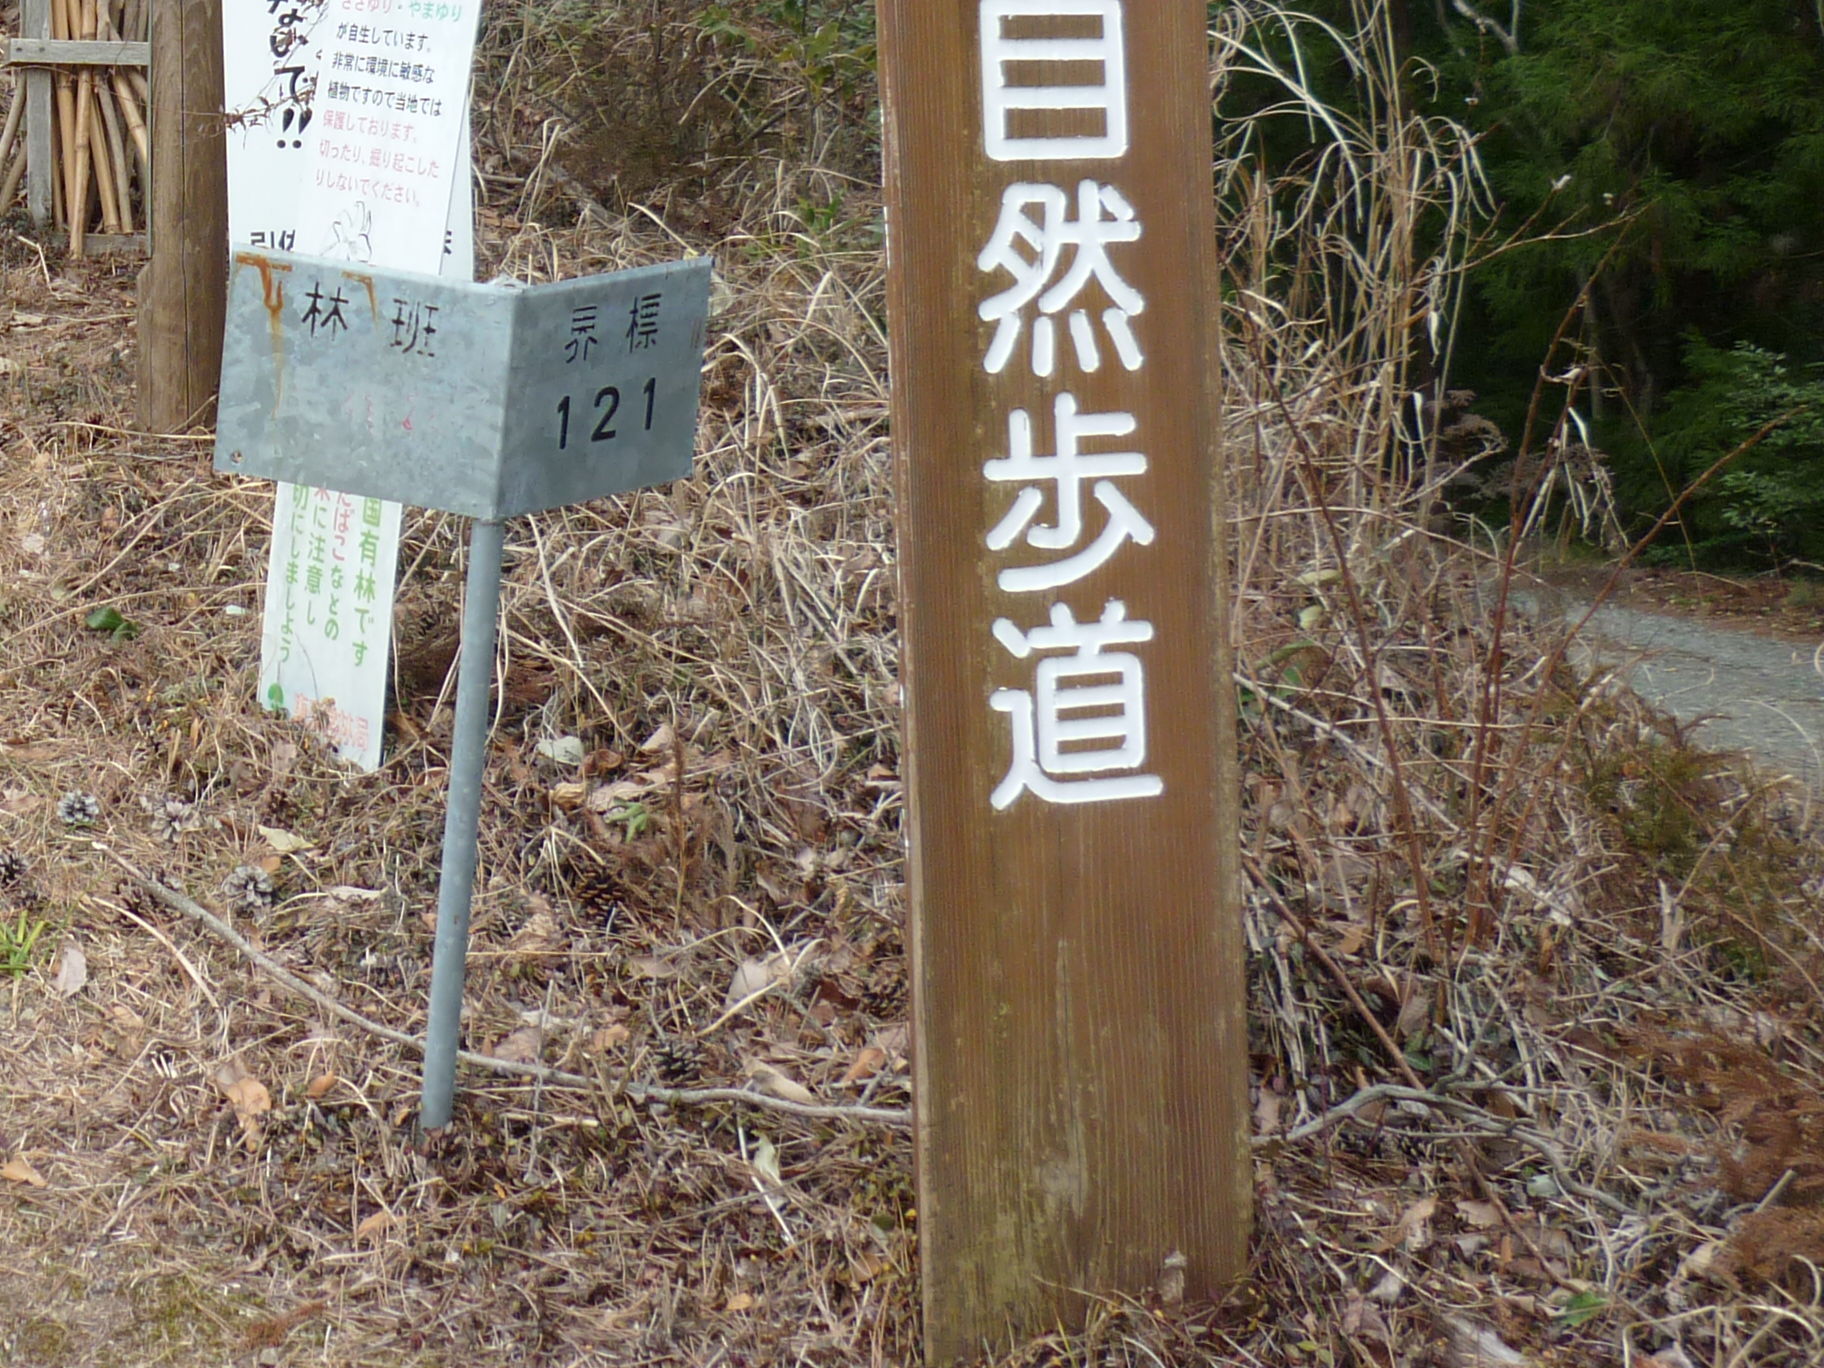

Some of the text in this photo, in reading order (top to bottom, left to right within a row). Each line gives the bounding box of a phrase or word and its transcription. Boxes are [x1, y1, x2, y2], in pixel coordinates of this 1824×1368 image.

[335, 21, 432, 53] が自生しています。
[331, 50, 436, 84] 非常に環境に敏感な
[327, 80, 443, 117] 植物ですので当地では
[322, 108, 419, 144] 保護しております。
[318, 138, 441, 179] 切ったり、掘り起こした
[557, 377, 656, 450] 121
[351, 496, 384, 667] 国有林です
